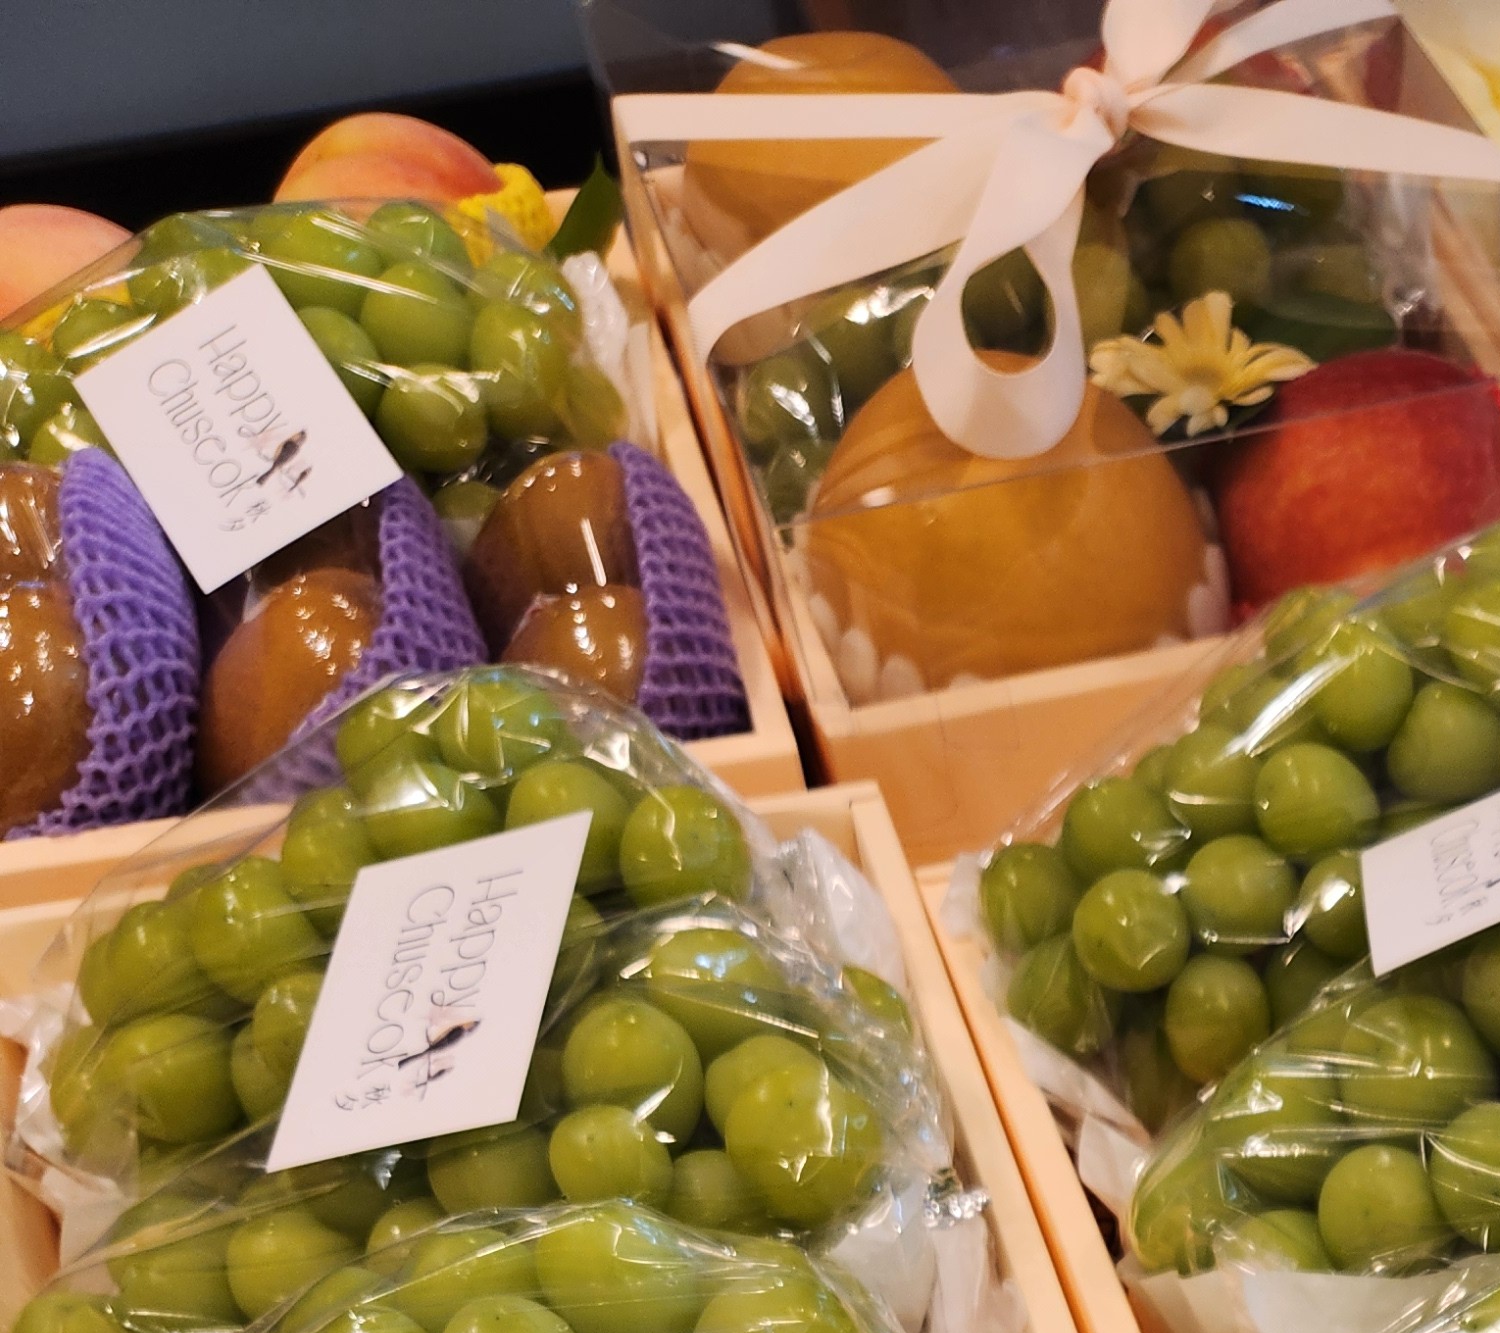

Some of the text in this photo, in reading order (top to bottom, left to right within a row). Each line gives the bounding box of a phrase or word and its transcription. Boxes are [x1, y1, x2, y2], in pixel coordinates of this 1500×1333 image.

[148, 358, 259, 507] Chuseok
[199, 324, 288, 438] Happy
[357, 885, 455, 1079] Chuseok
[431, 870, 523, 1008] Happy
